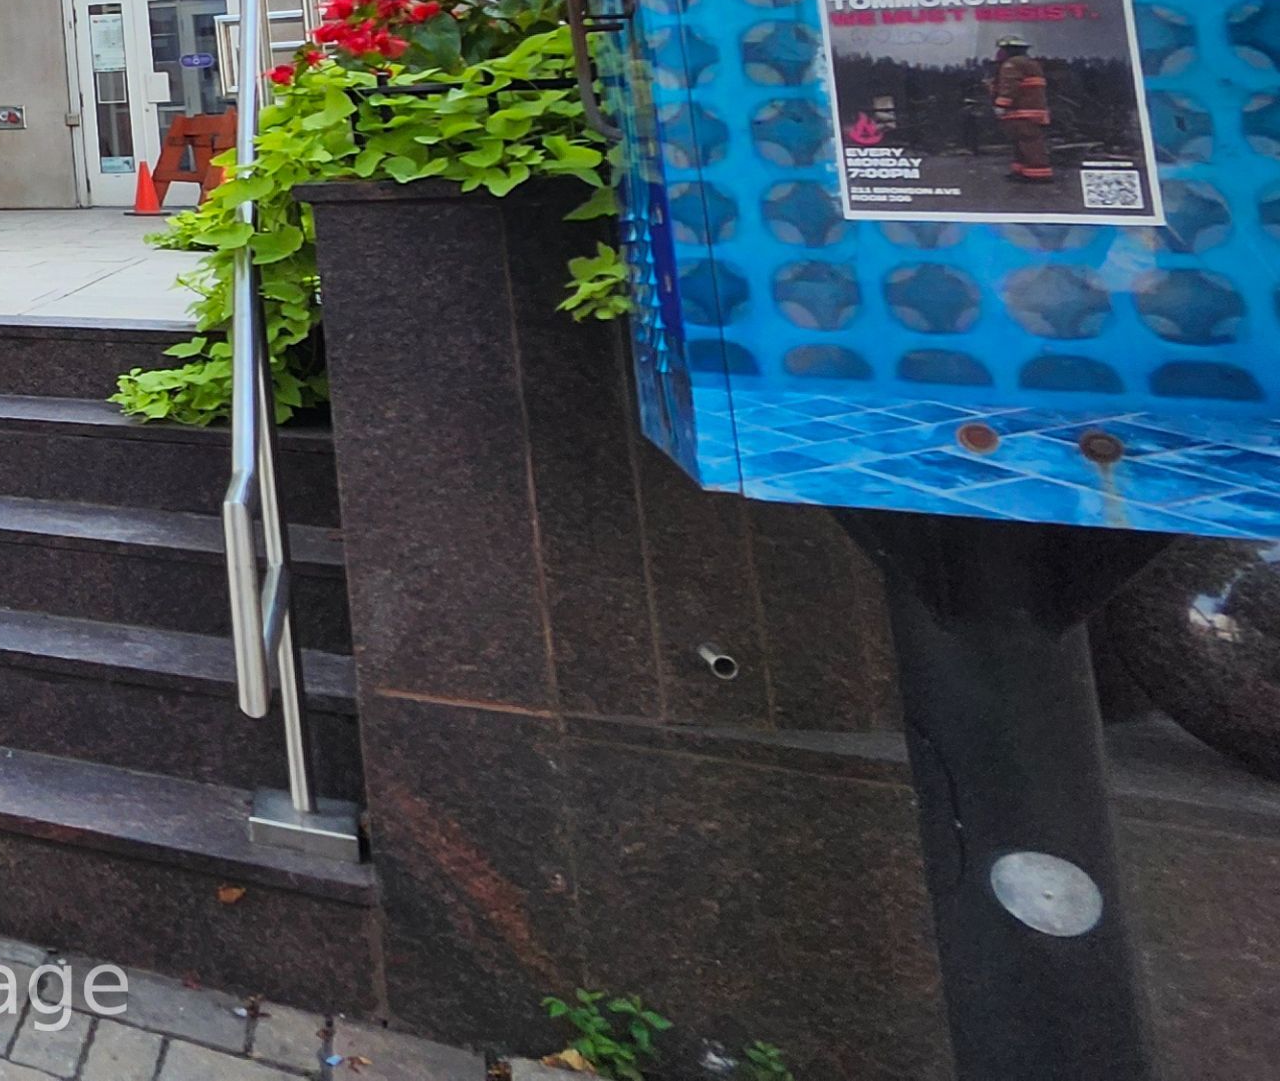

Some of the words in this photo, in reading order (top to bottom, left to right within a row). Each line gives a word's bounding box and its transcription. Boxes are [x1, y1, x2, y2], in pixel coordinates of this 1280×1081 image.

[831, 10, 876, 27] WE
[882, 7, 970, 26] MUST
[845, 148, 904, 158] EVERY
[846, 158, 922, 168] MONDAY
[848, 168, 920, 179] 7:00PM
